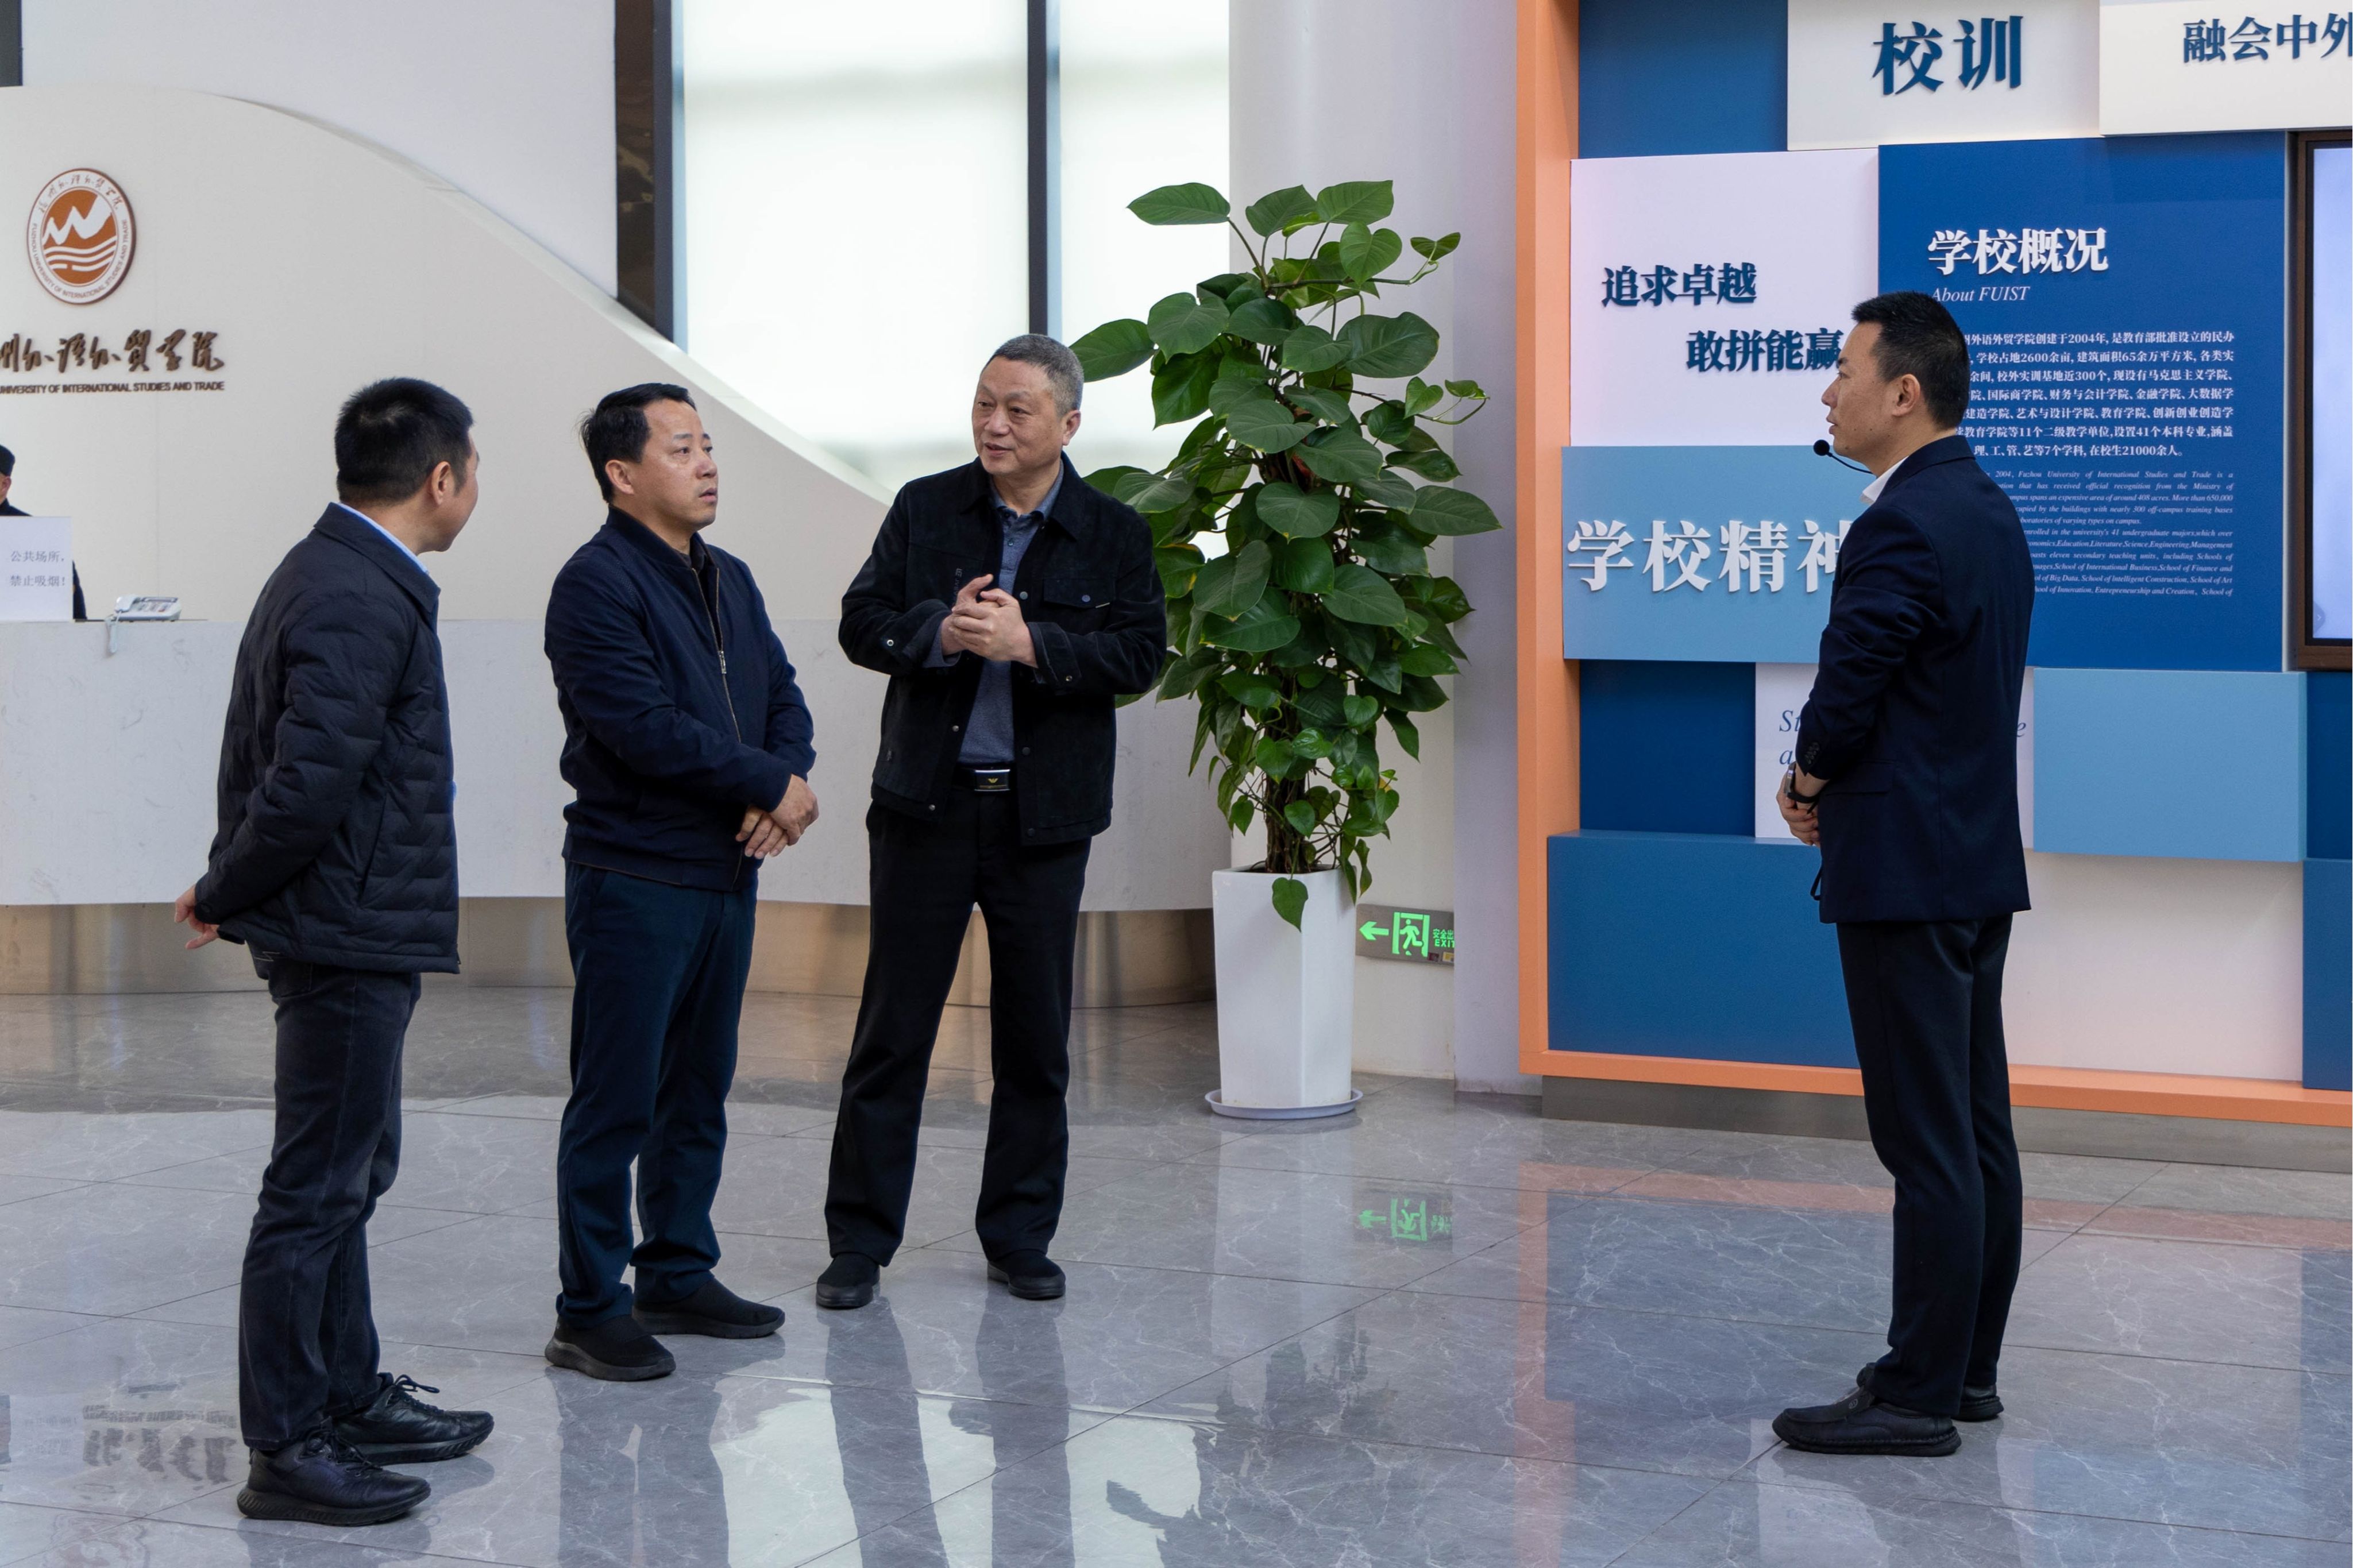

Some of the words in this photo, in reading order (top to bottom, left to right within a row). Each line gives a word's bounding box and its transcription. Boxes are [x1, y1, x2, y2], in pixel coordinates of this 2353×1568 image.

[2183, 12, 2353, 63] 融会中外
[1873, 16, 2024, 95] 校训
[1927, 228, 2109, 276] 学校概况
[1601, 262, 1757, 307] 追求卓越
[1932, 287, 1975, 302] About
[1978, 286, 2031, 302] FUIST
[1686, 327, 1844, 372] 敢拼能赢
[48, 384, 60, 393] OF
[62, 383, 132, 393] INTERNATIONAL
[133, 382, 171, 392] STUDIES
[173, 381, 192, 391] AND
[194, 381, 225, 391] TRADE
[1969, 388, 2234, 401] 院、国际商学院、财务与会计学院、金融学院、大数据学
[1963, 407, 2234, 419] 建造学院、艺术与设计学院、教育学院、创新创业创造学
[2047, 470, 2080, 479] University
[2086, 482, 2108, 491] official
[2156, 482, 2171, 491] from
[2054, 517, 2061, 525] of
[2163, 553, 2194, 561] including
[2078, 563, 2085, 571] of
[2042, 574, 2049, 582] of
[2049, 574, 2061, 582] Big
[2112, 576, 2145, 584] Intelligent
[2049, 586, 2057, 594] of
[2094, 586, 2151, 595] Entrepreneurship
[2225, 588, 2234, 597] of
[1434, 939, 1455, 948] EXIT
